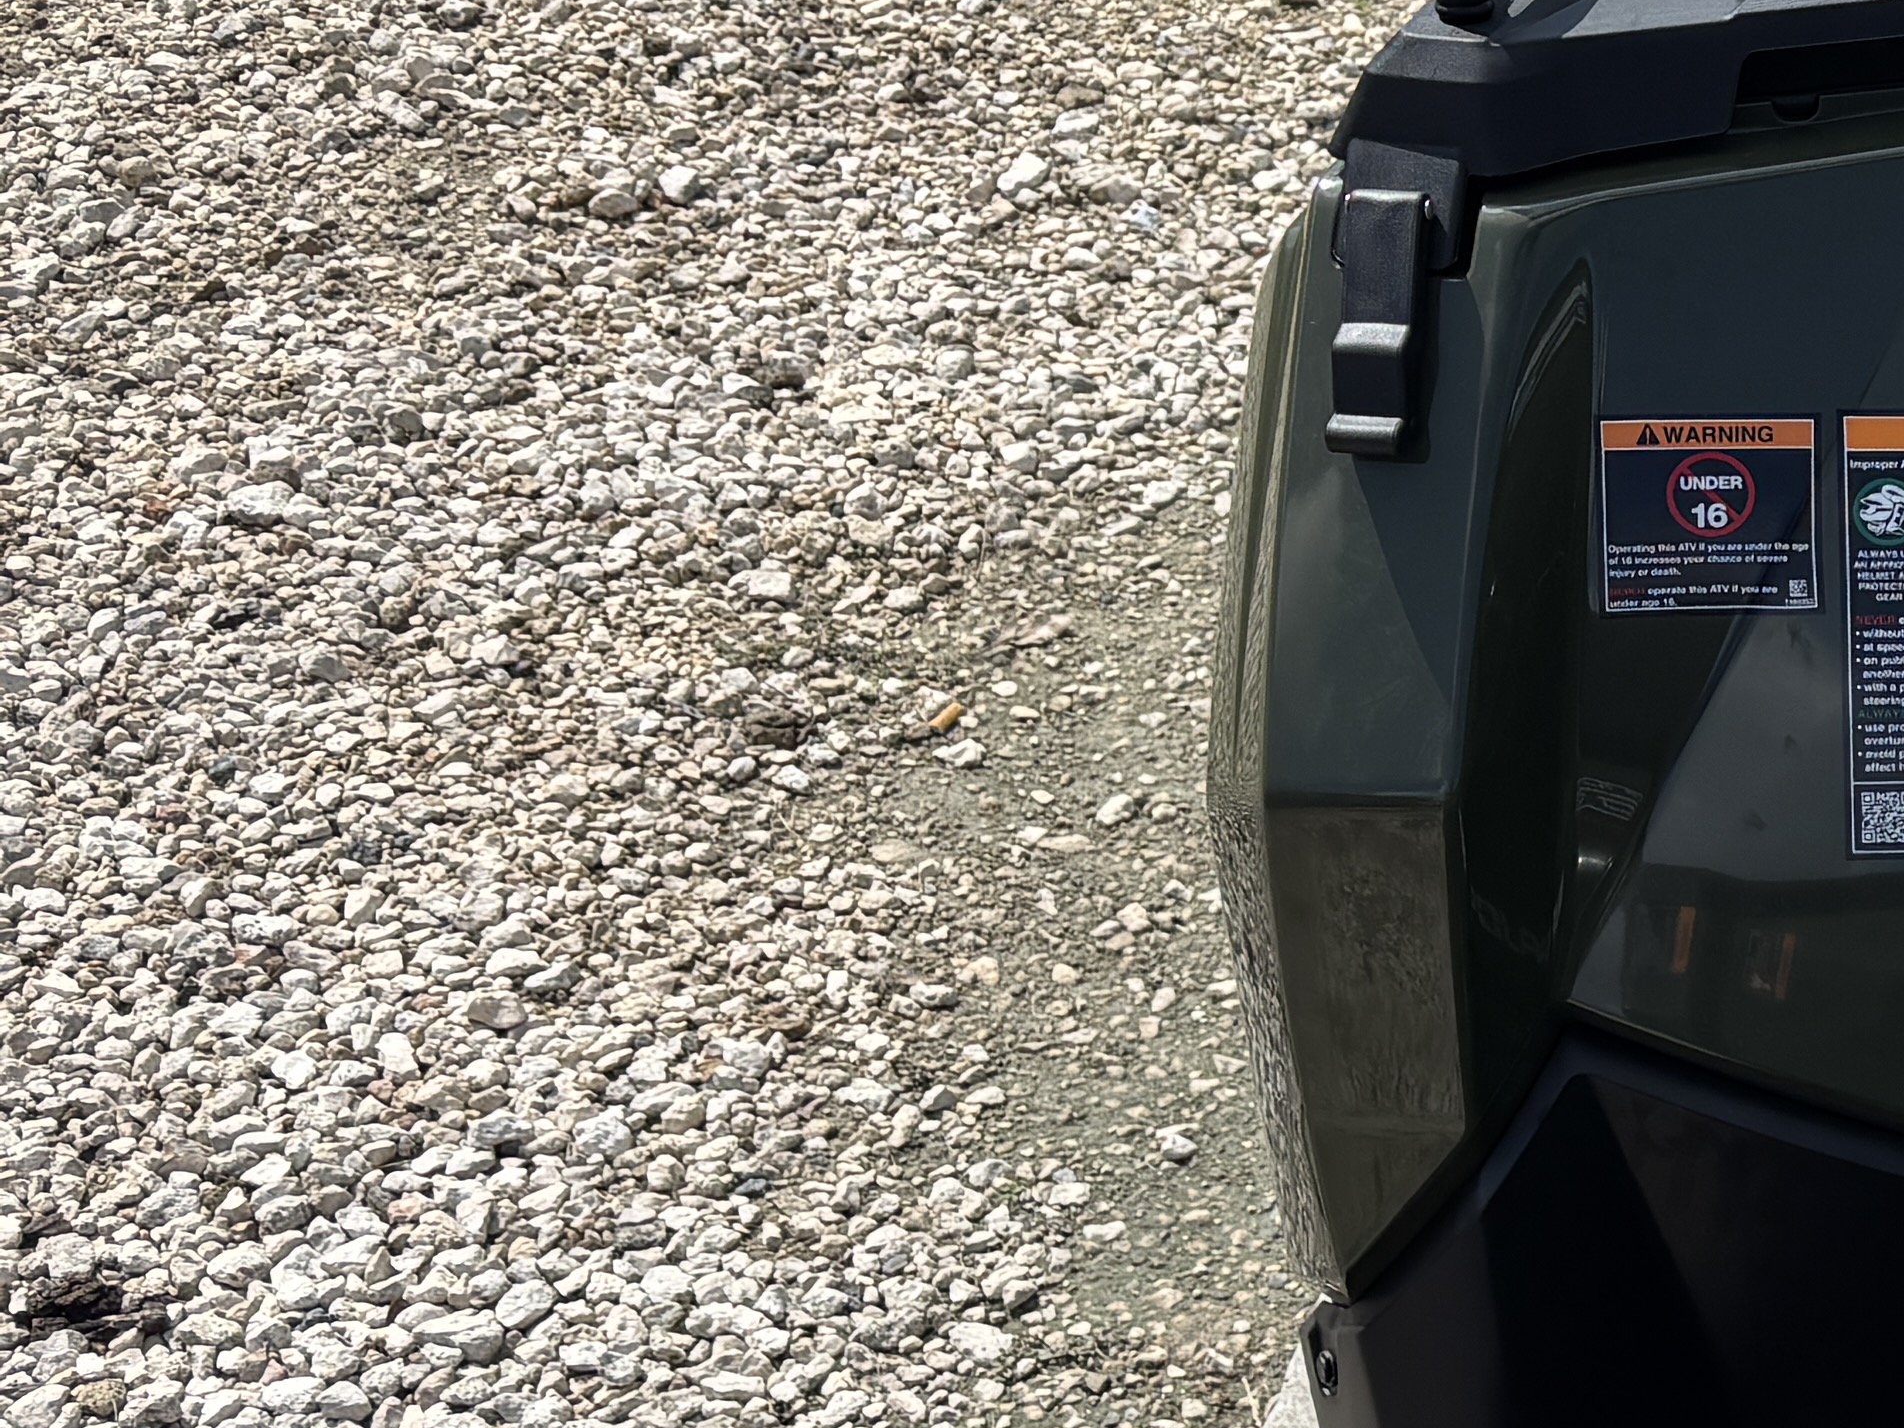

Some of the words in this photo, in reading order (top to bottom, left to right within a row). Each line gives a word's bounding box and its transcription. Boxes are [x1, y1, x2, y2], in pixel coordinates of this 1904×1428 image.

[1663, 425, 1774, 444] WARNING
[1849, 459, 1898, 471] Improper
[1679, 475, 1743, 491] UNDER
[1691, 502, 1729, 528] 16
[1608, 544, 1656, 554] Operating
[1658, 543, 1676, 552] this
[1678, 543, 1696, 551] ATV
[1707, 544, 1725, 553] you
[1744, 543, 1772, 551] under
[1774, 542, 1790, 550] the
[1791, 543, 1809, 552] age
[1634, 555, 1681, 564] increases
[1683, 555, 1705, 565] your
[1707, 554, 1742, 564] chance
[1744, 554, 1755, 563] of
[1756, 554, 1788, 563] severe
[1857, 550, 1898, 559] ALWAYS
[1608, 568, 1636, 578] injury
[1650, 567, 1682, 577] death.
[1647, 586, 1686, 596] operate
[1688, 585, 1707, 594] this
[1709, 585, 1730, 594] ATV
[1740, 585, 1760, 595] you
[1761, 585, 1779, 594] are
[1609, 598, 1638, 608] under
[1862, 628, 1904, 638] without
[1863, 657, 1878, 666] on
[1863, 682, 1888, 692] with
[1864, 723, 1885, 732] use
[1865, 763, 1896, 773] affect
